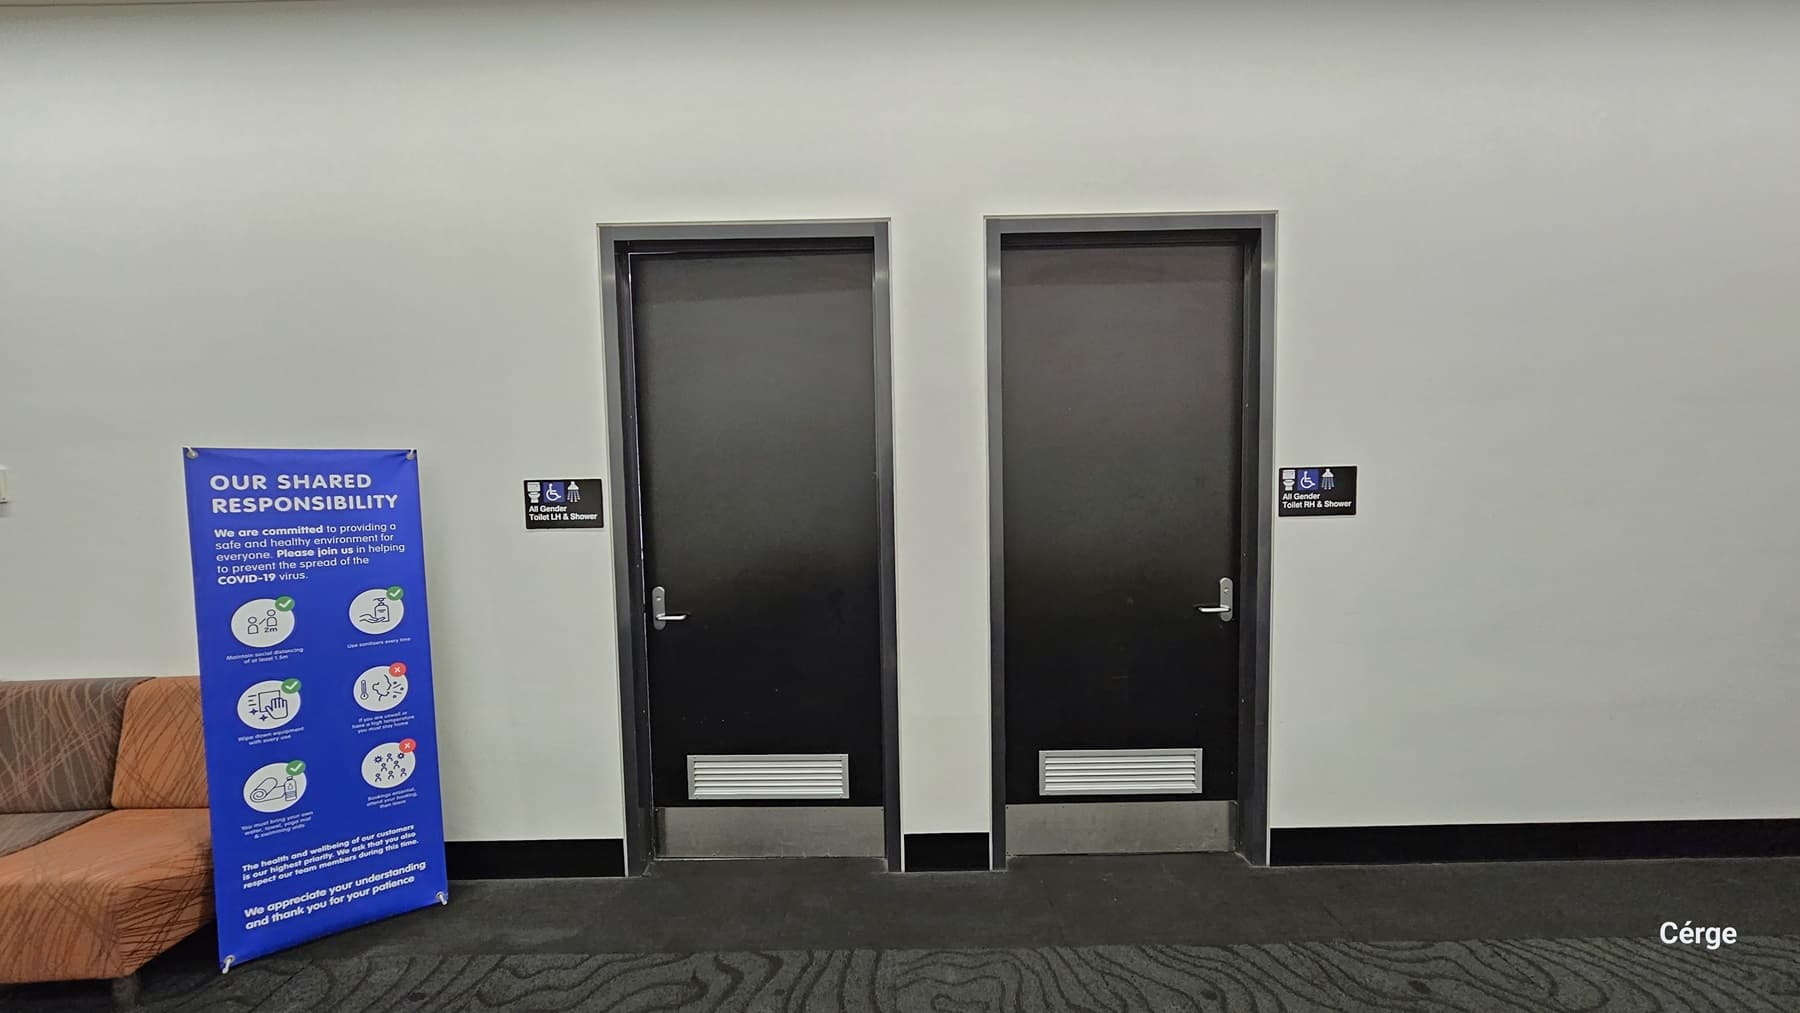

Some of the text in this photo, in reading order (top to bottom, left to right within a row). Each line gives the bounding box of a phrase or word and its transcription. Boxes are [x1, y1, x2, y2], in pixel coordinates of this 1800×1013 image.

[210, 474, 372, 490] OUR SHARED
[212, 494, 398, 513] RESPONSIBILITY
[214, 529, 235, 538] We
[238, 529, 258, 537] are
[262, 525, 323, 536] committed
[327, 525, 336, 533] to
[340, 523, 387, 534] providing
[216, 534, 394, 550] safe and healthy environment for
[216, 551, 272, 562] everyone.
[277, 549, 314, 558] Please
[317, 546, 338, 557] join
[357, 545, 366, 553] in
[368, 544, 405, 554] helping
[217, 556, 369, 573] to prevent the spread of the
[218, 571, 308, 585] COVID-19 virus.
[261, 855, 289, 867] health
[291, 850, 308, 859] and
[310, 841, 349, 854] wellbeing
[351, 836, 359, 844] of
[361, 834, 375, 842] our
[376, 824, 414, 838] customers
[270, 861, 302, 873] highest
[304, 853, 335, 866] priority.
[352, 844, 365, 852] ask
[367, 840, 383, 848] that
[400, 832, 416, 840] also
[243, 875, 276, 889] respect
[278, 871, 293, 879] our
[295, 865, 317, 875] team
[319, 855, 356, 869] members
[358, 848, 383, 858] during
[385, 844, 399, 852] this
[244, 861, 426, 918] We appreciate your understanding
[245, 876, 415, 930] and thank you for your patience
